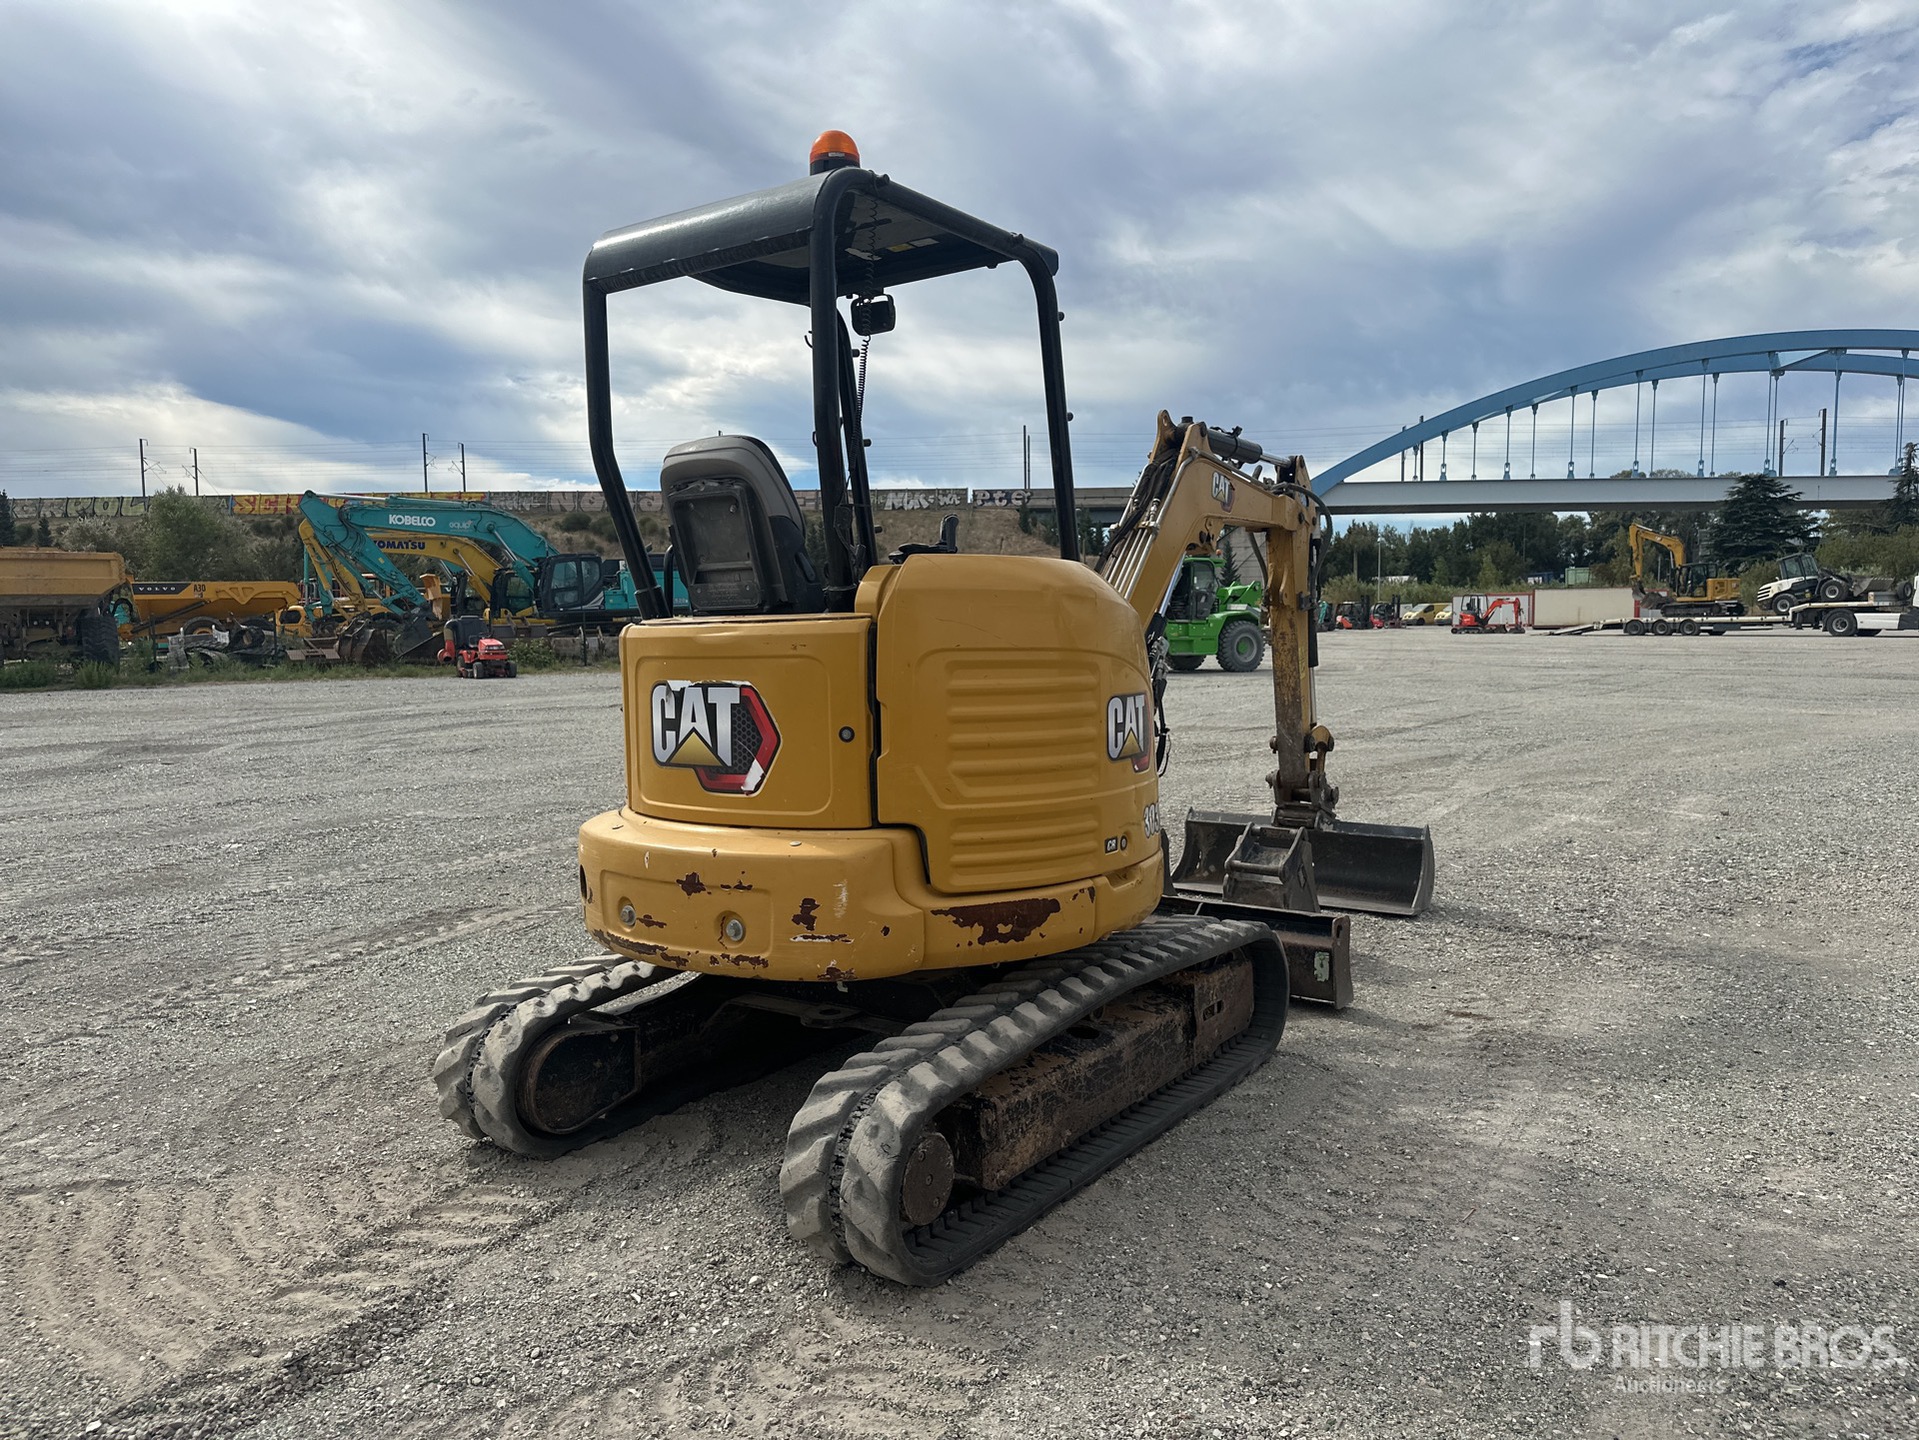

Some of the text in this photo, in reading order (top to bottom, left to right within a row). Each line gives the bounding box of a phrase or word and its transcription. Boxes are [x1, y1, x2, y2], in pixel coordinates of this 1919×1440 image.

[1212, 472, 1231, 503] CAT
[389, 514, 436, 527] KOBELCO
[652, 685, 741, 767] CAT
[1108, 694, 1146, 760] CAT
